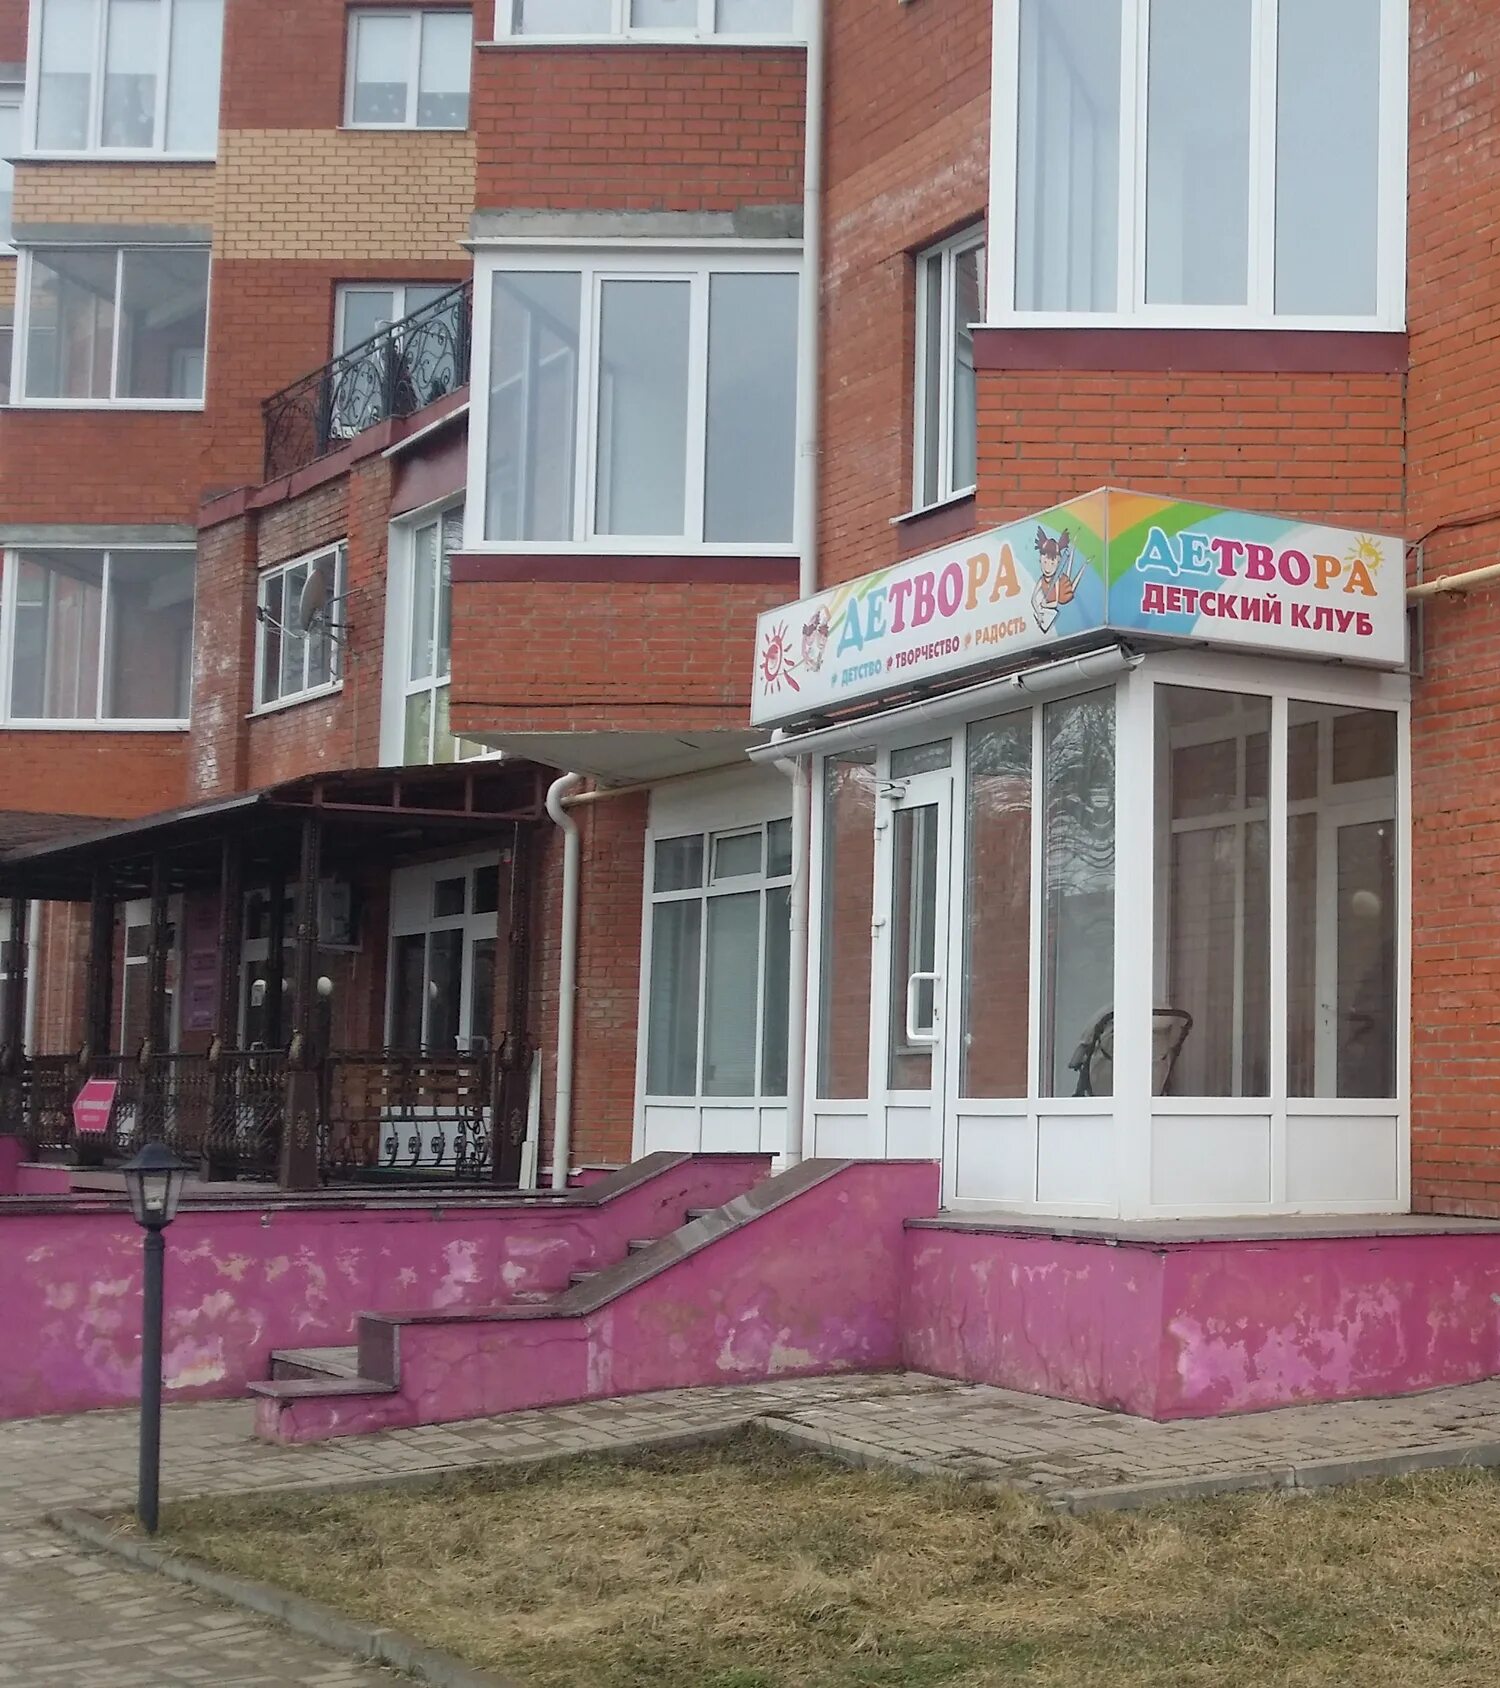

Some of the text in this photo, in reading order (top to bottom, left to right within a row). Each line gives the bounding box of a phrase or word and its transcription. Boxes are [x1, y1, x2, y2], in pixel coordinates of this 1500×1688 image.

[1135, 527, 1378, 597] ДЕТВОРА
[837, 543, 1021, 658] ДЕТВОРА
[1142, 583, 1374, 636] ДЕТСКИЙ КЛУБ
[841, 616, 1026, 686] ДЕТСТВО ТВОРЧЕСТВО РАДОСТЬ
